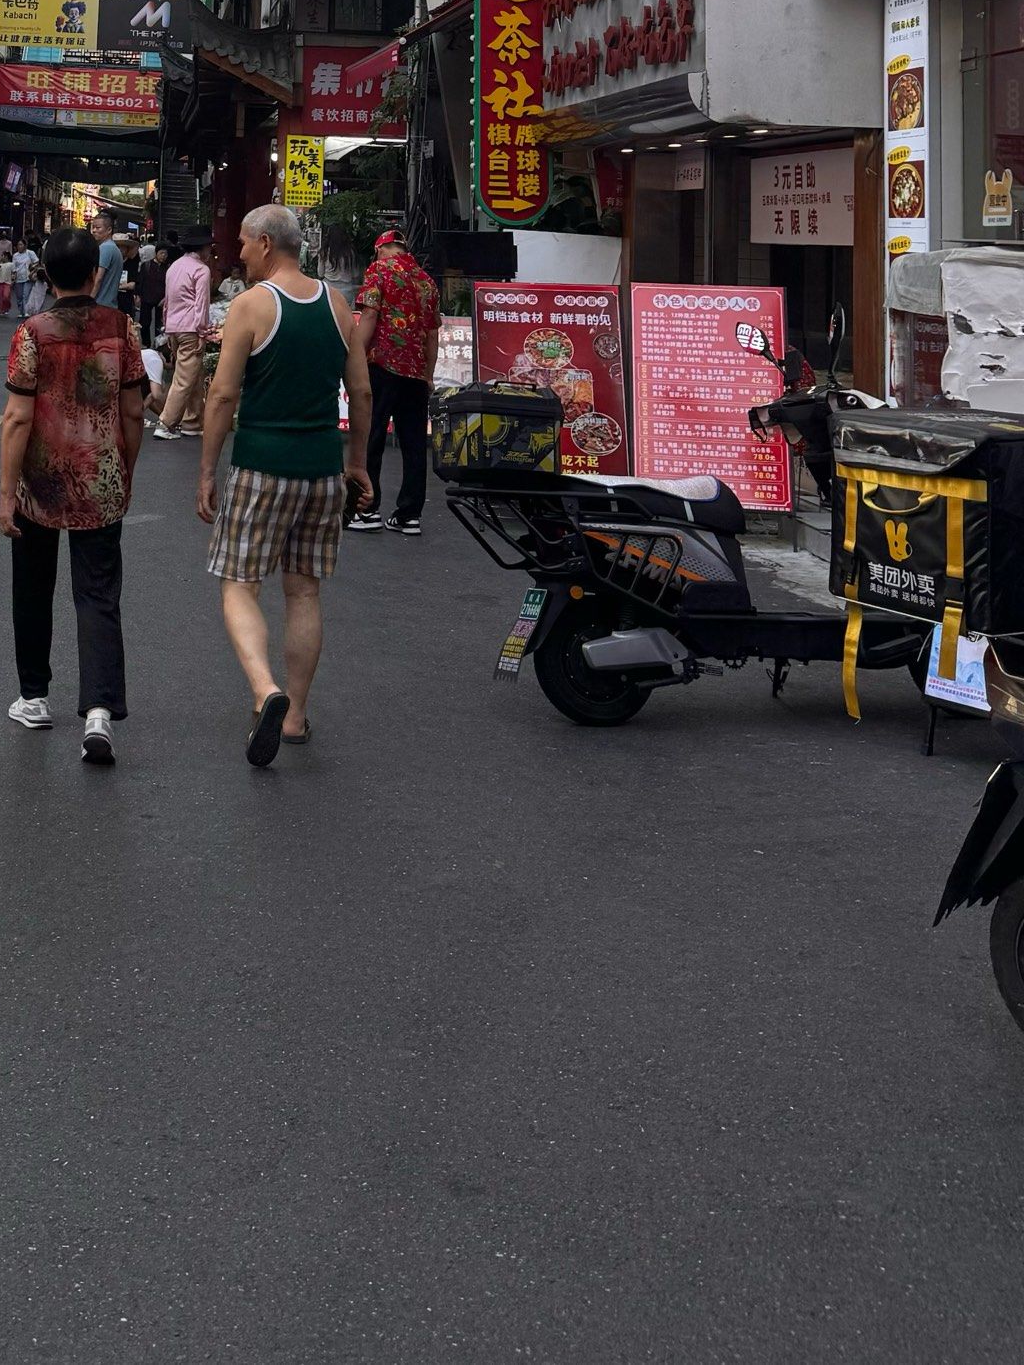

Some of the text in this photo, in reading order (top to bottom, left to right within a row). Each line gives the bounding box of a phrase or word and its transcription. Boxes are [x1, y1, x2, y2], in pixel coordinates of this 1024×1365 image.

[3, 10, 38, 21] Kabachi
[0, 34, 87, 46] 让健康生活有保证
[107, 96, 143, 109] 5602
[774, 161, 817, 190] 3元自助
[774, 208, 819, 236] 无限续
[652, 293, 761, 312] 特色冒菜单人餐
[483, 310, 612, 328] 明档选食材 新鲜看的见
[561, 455, 599, 468] 吃不起
[867, 561, 936, 597] 美团外卖
[869, 583, 898, 599] 美团外卖
